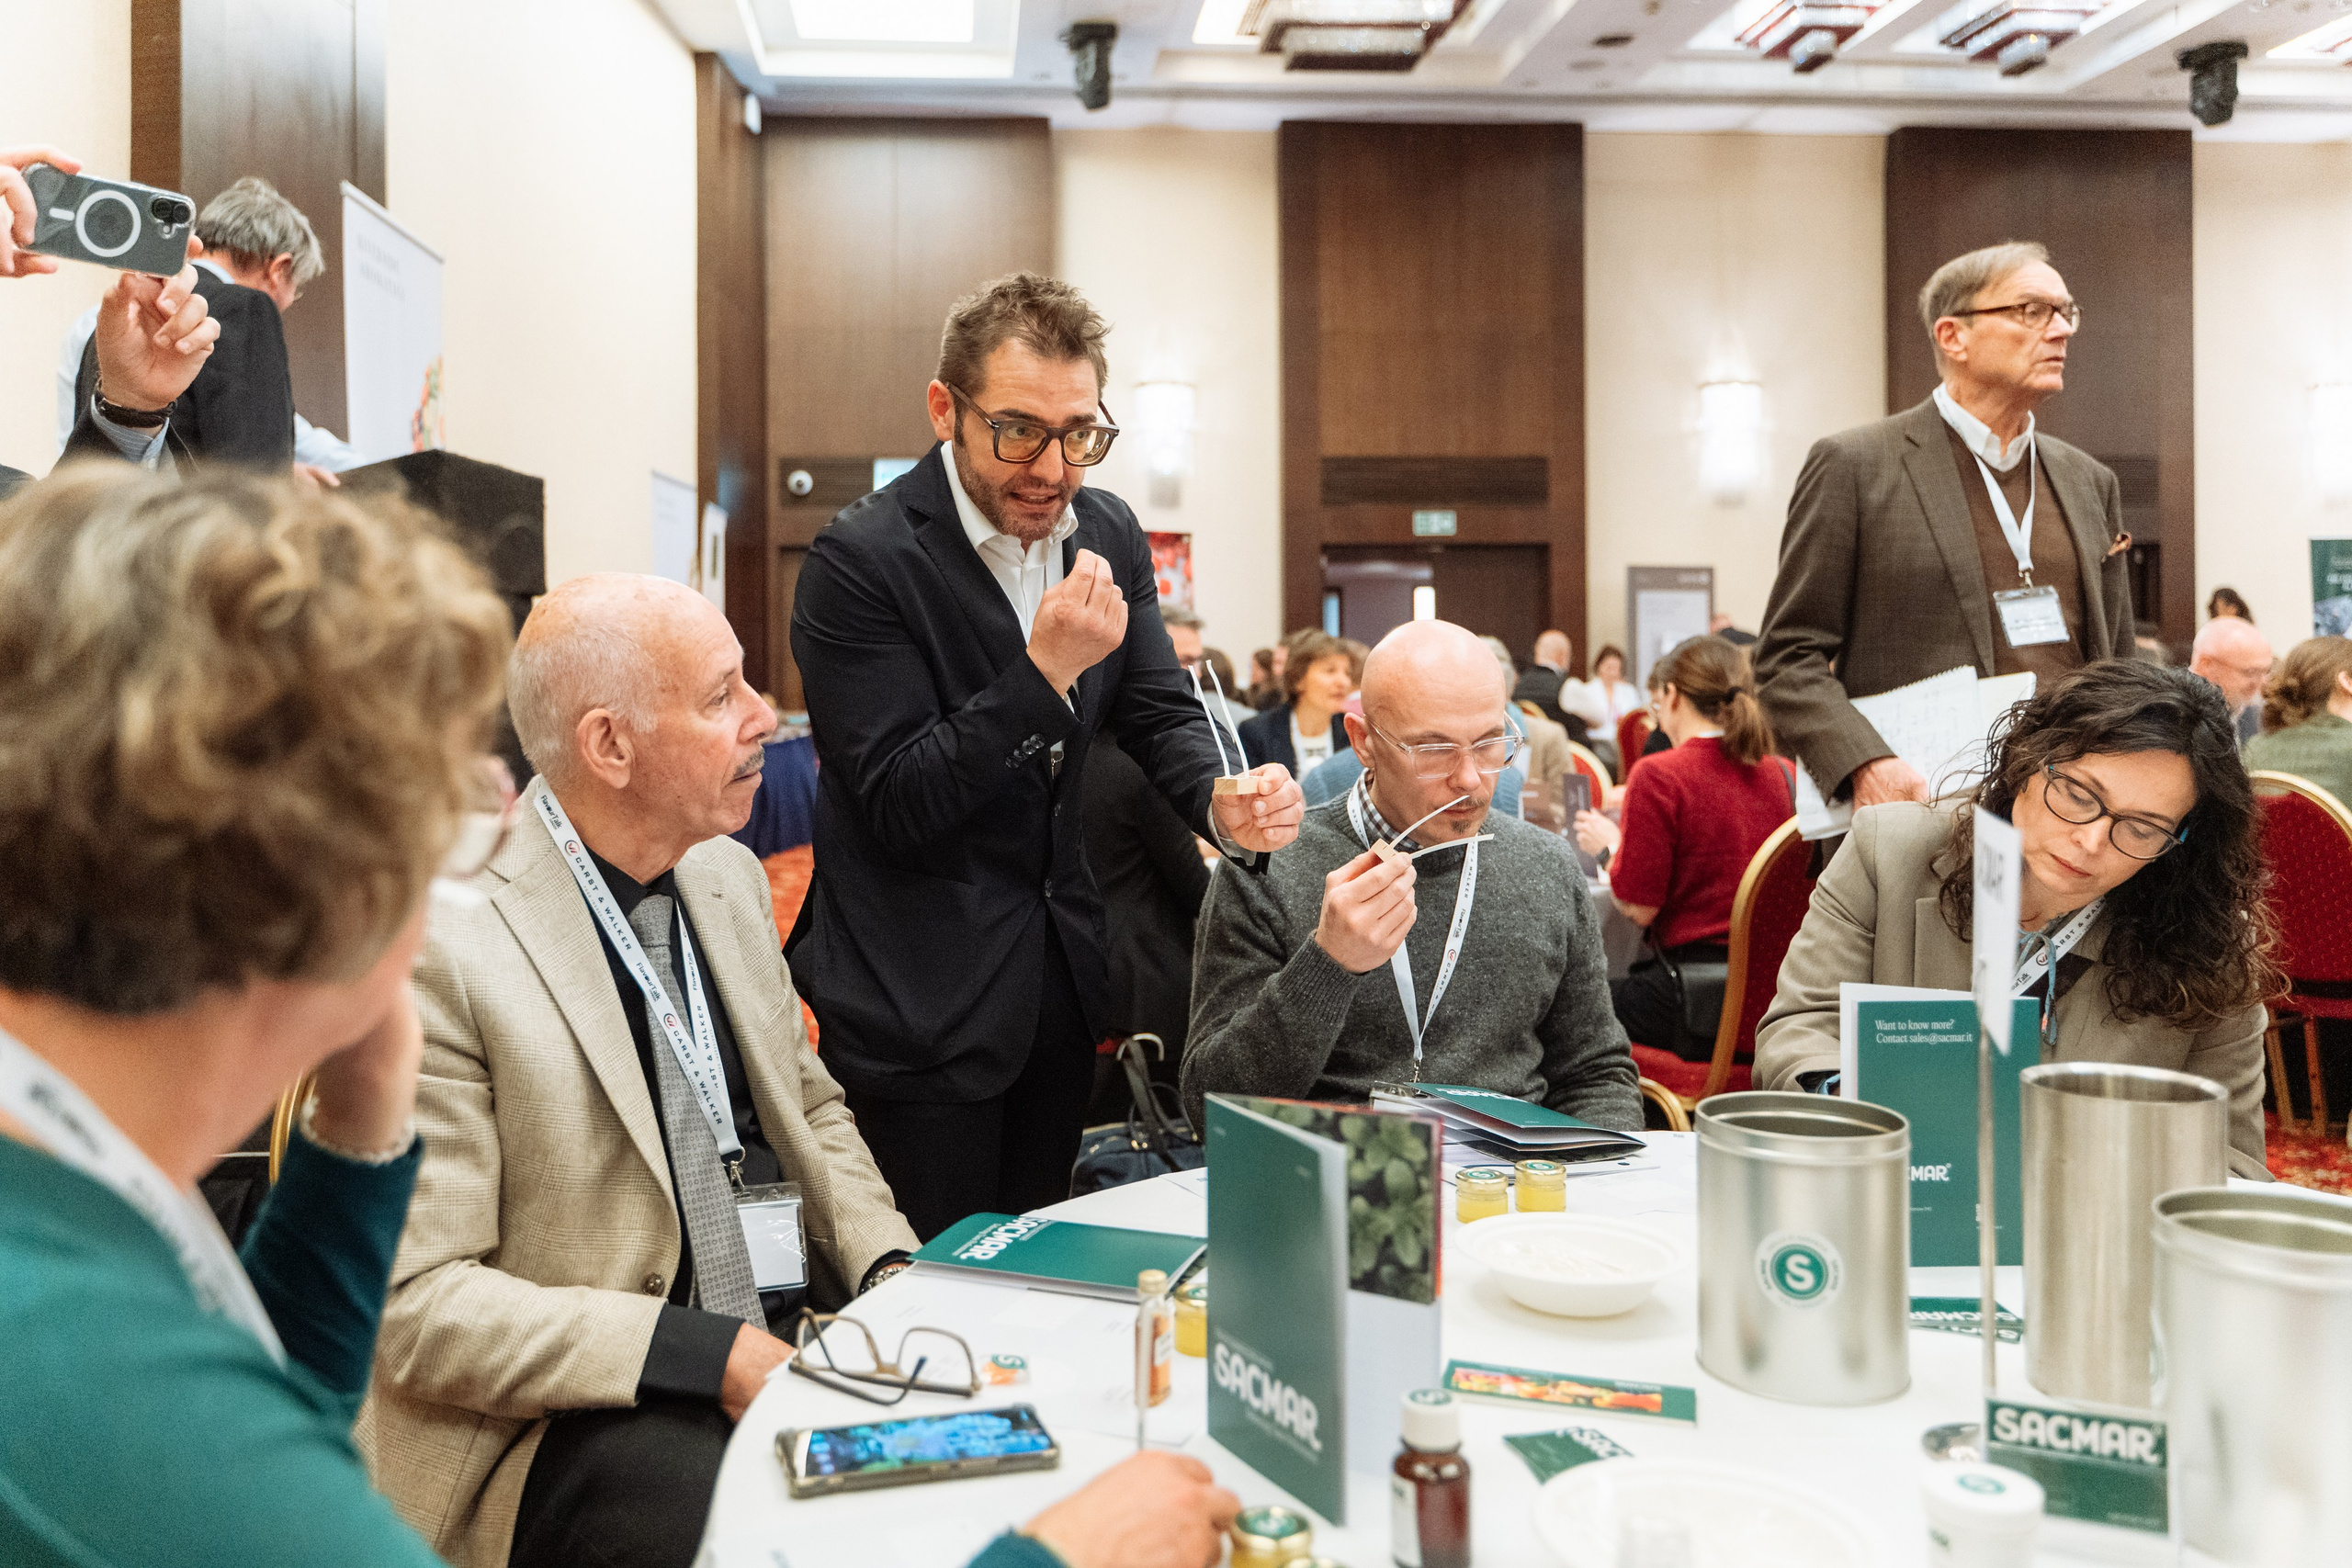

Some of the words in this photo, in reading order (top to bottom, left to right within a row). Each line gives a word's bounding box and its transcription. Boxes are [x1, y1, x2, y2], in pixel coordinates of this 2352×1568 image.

[540, 795, 562, 829] FlavourTalk
[575, 856, 599, 891] CARST
[605, 908, 632, 952] WALKER
[2056, 930, 2075, 950] ARST
[636, 962, 662, 1001] FlavourTalk
[697, 1005, 711, 1051] WALKER
[1875, 1020, 1896, 1031] Want
[1898, 1021, 1906, 1030] to
[1907, 1020, 1929, 1030] know
[1931, 1019, 1955, 1030] more?
[1876, 1032, 1907, 1043] Contact
[1909, 1032, 1973, 1045] sales@sacmar.it
[673, 1031, 695, 1066] CARST
[699, 1080, 723, 1125] WALKER
[1908, 1165, 1950, 1181] MAR
[1785, 1254, 1815, 1291] S
[1909, 1312, 2017, 1321] SCMAR
[1213, 1341, 1323, 1452] SACMAR
[1993, 1406, 2158, 1464] SACMAR
